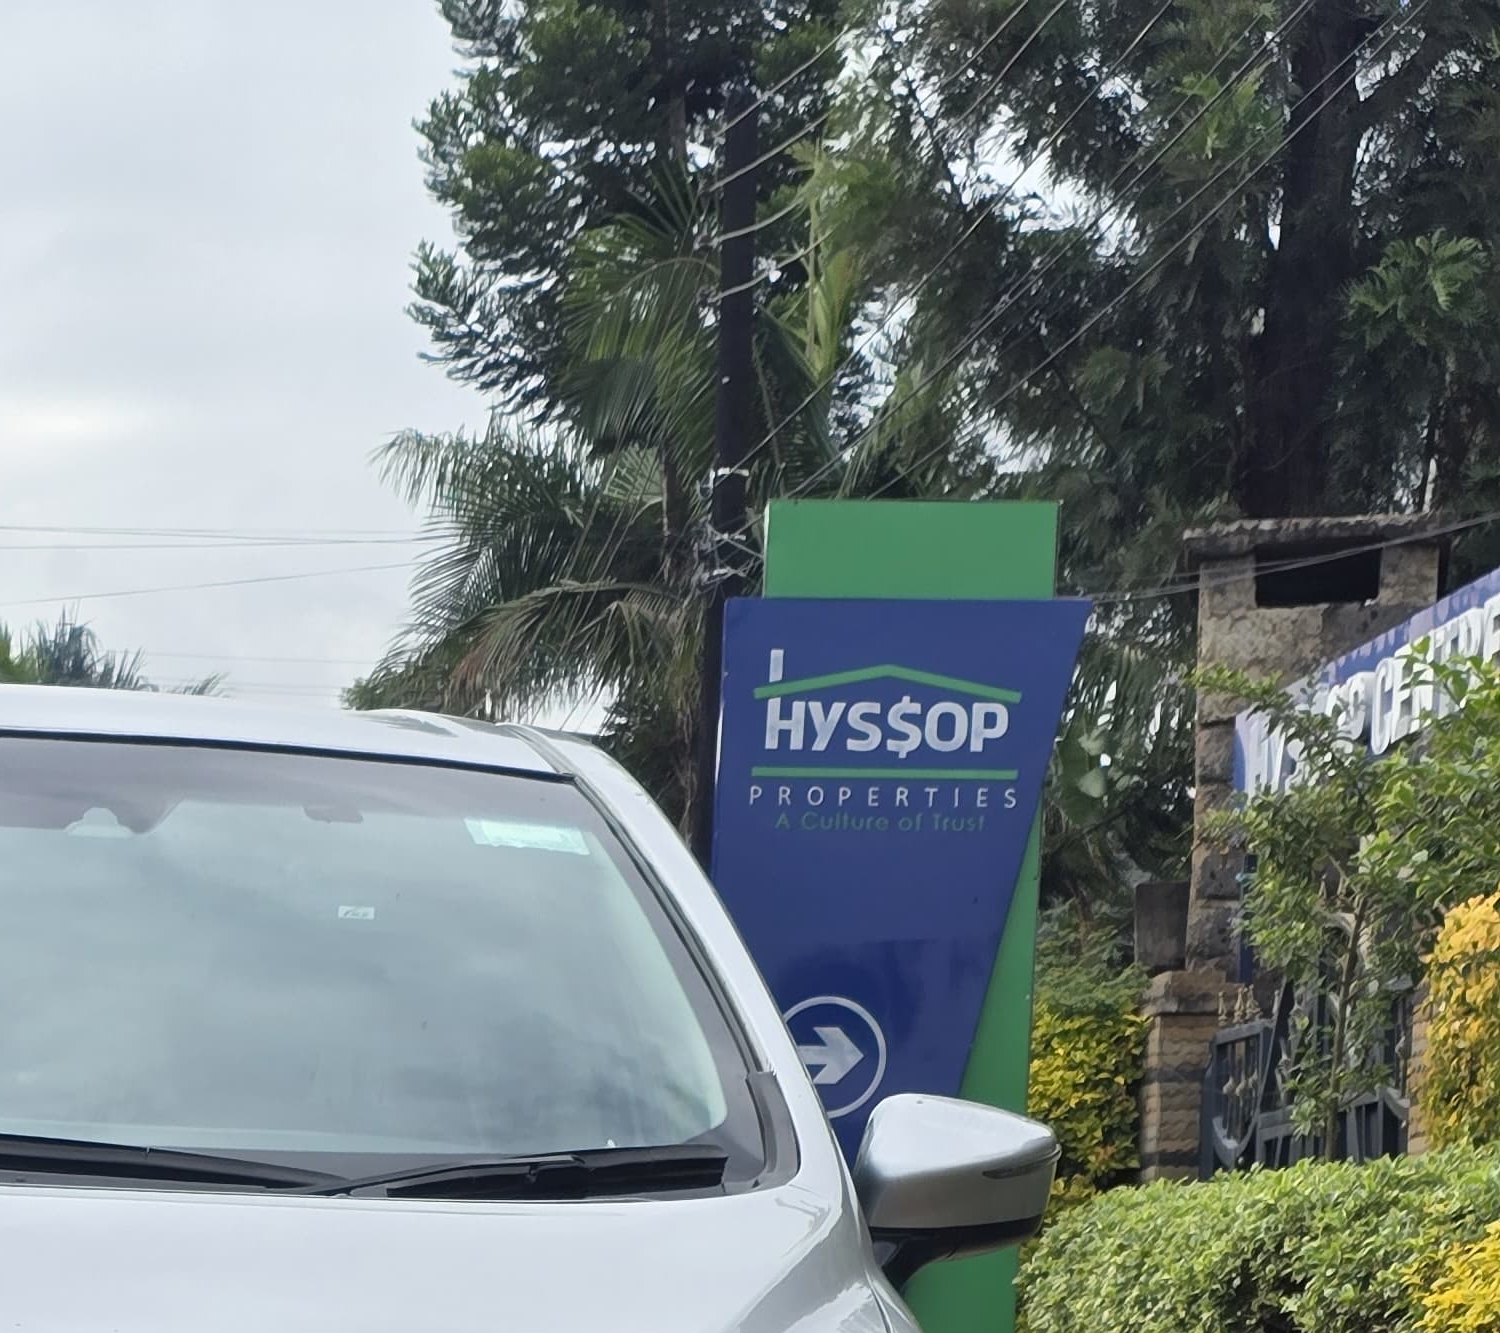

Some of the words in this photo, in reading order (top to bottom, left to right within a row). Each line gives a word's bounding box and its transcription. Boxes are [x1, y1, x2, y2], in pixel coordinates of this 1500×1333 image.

[749, 785, 1018, 809] PROPERTIES
[774, 812, 791, 831] A
[801, 811, 889, 832] Culture
[897, 812, 922, 832] of
[931, 813, 986, 832] Trust
